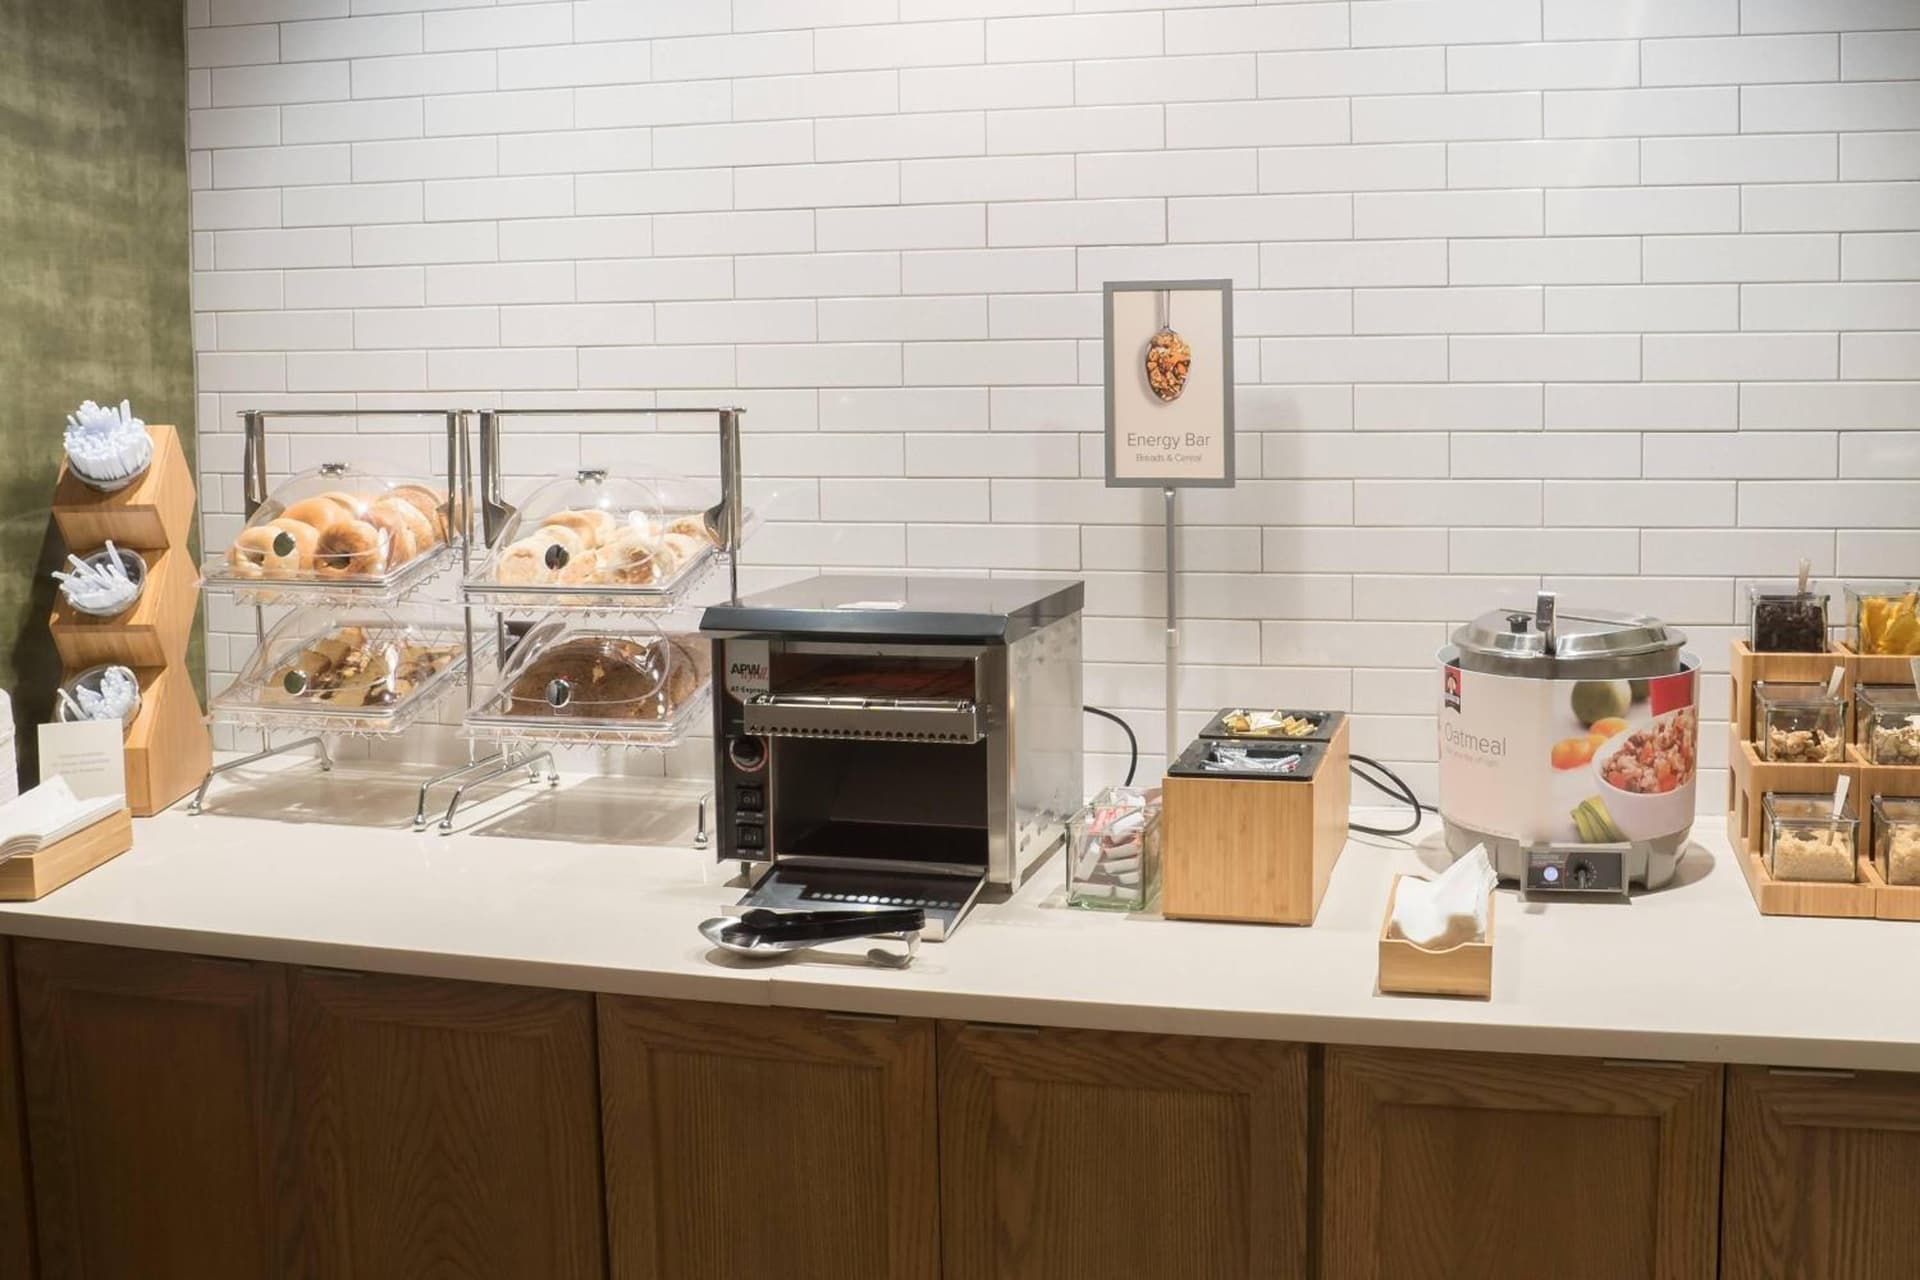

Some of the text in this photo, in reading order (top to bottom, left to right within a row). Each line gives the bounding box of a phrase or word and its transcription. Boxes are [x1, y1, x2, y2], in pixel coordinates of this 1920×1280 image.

[1127, 431, 1211, 450] Energy Bar
[730, 662, 761, 675] APW
[1444, 721, 1507, 756] Oatmeal
